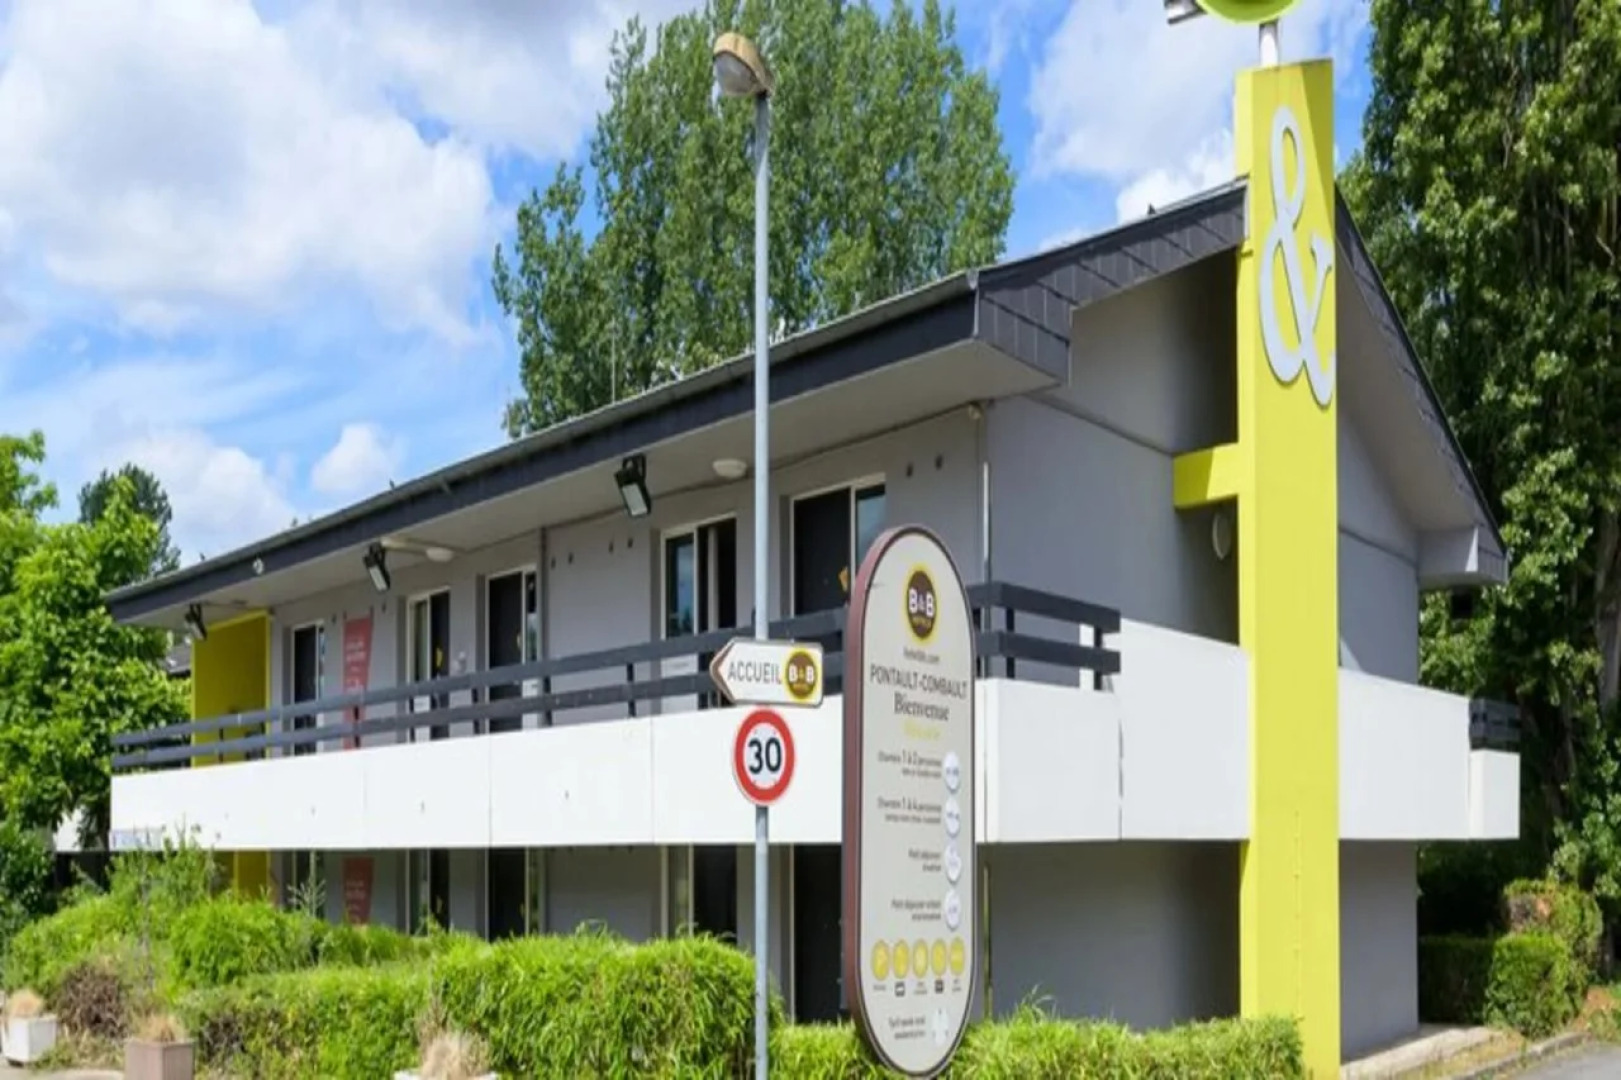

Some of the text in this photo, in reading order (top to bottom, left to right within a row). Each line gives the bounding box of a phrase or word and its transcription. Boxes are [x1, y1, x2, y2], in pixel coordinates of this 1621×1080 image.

[1259, 105, 1336, 411] &
[908, 588, 935, 618] B&B
[727, 661, 782, 685] ACCUEIL
[870, 663, 967, 699] PONTAULT-COMBAULT
[894, 691, 949, 721] Bienvenue
[748, 737, 782, 775] 30
